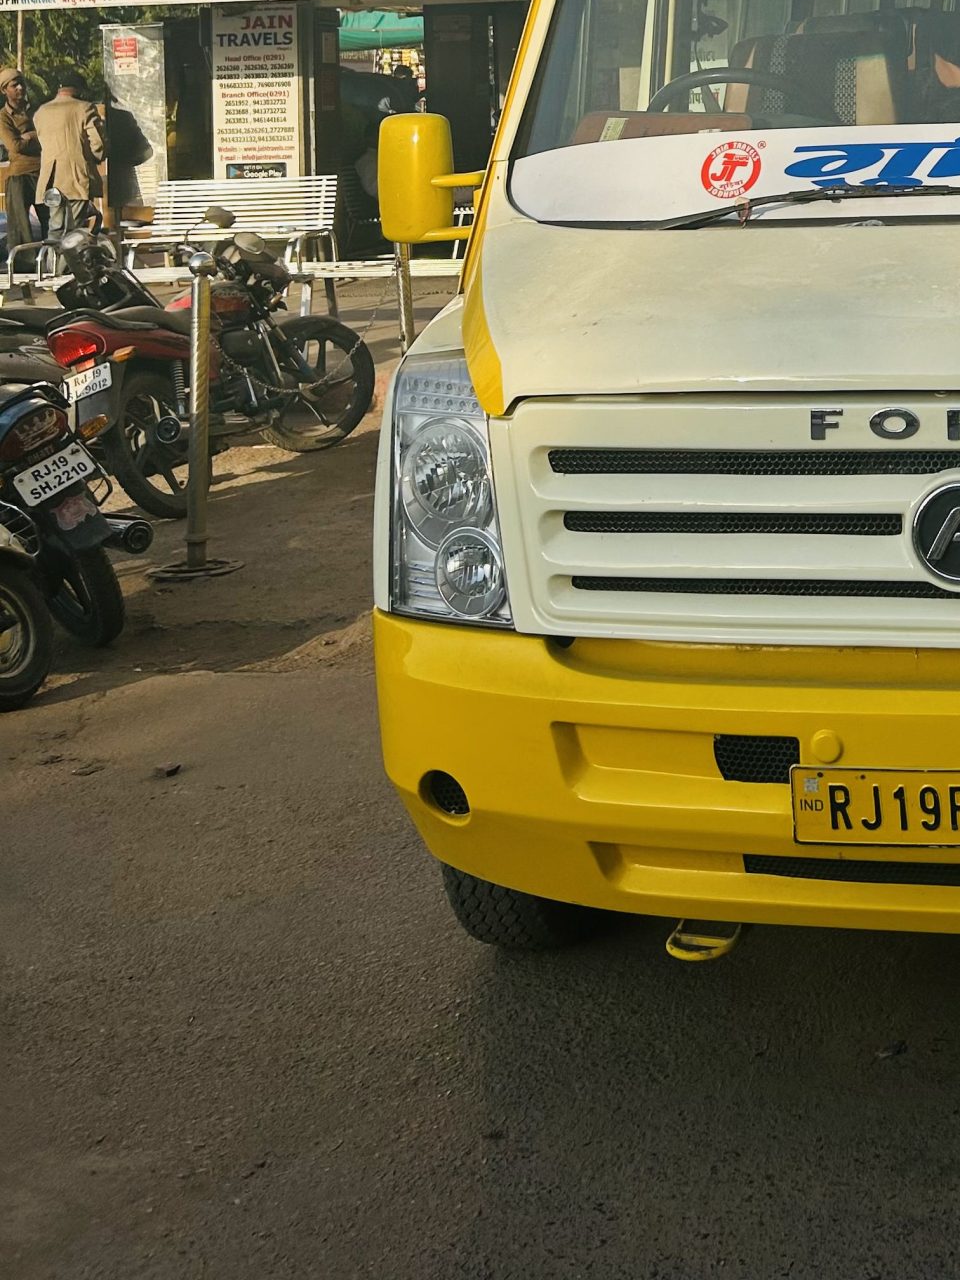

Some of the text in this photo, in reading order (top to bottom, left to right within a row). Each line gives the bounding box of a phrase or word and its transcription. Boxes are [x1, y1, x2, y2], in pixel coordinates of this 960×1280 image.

[241, 14, 293, 30] JAIN
[216, 31, 293, 48] TRAVELS
[244, 170, 282, 179] Google Play
[30, 462, 88, 499] SH.2210
[800, 798, 824, 812] IND
